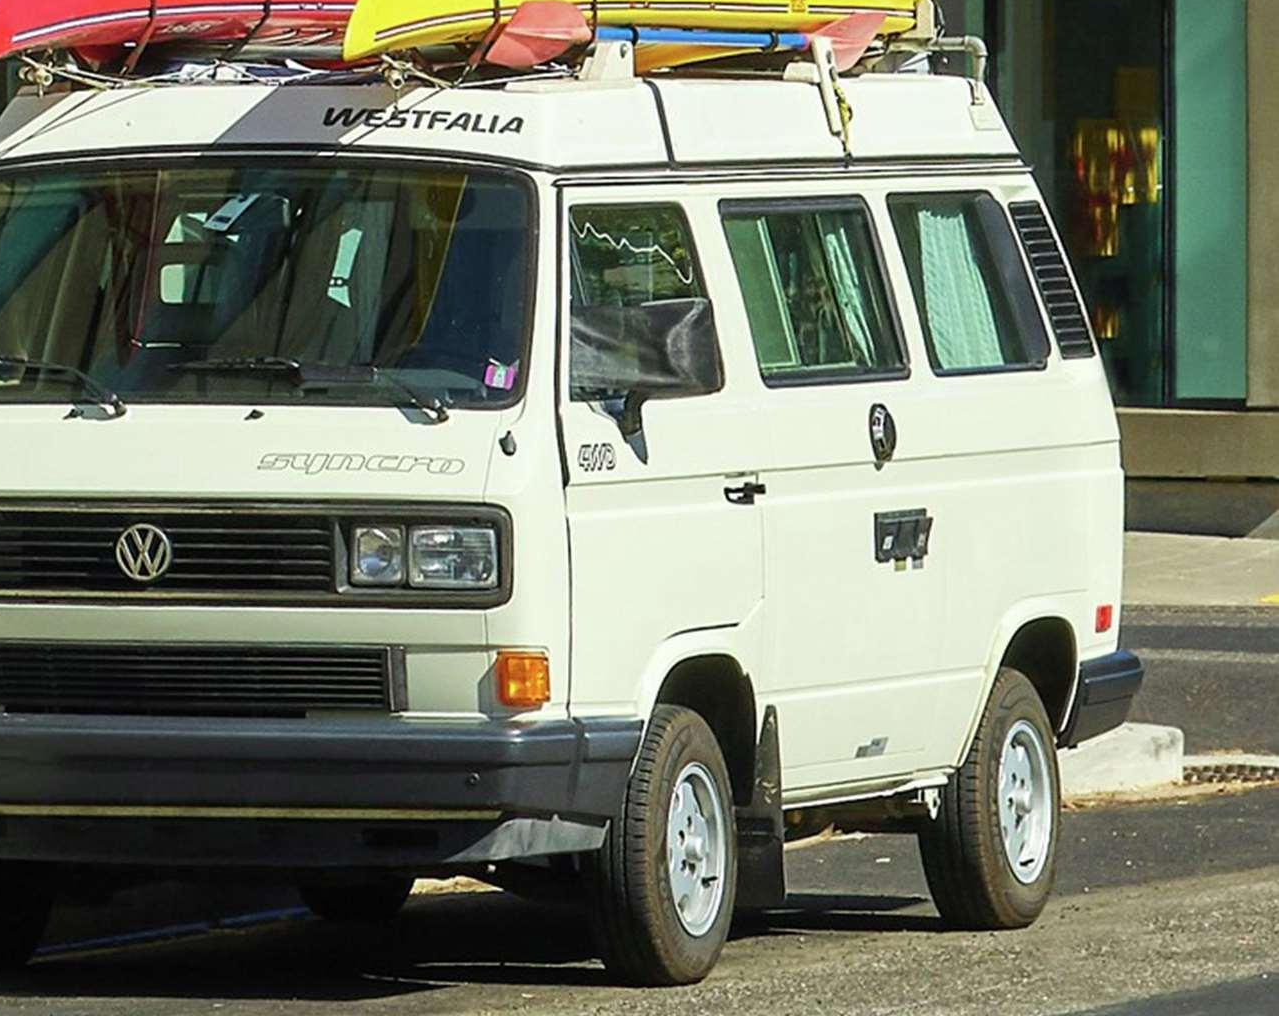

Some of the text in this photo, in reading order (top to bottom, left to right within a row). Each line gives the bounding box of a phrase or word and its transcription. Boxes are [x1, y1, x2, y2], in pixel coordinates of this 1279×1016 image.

[323, 107, 524, 134] WESTFALIA
[257, 453, 465, 475] syncro
[577, 443, 617, 472] 4WD
[116, 524, 170, 580] VW
